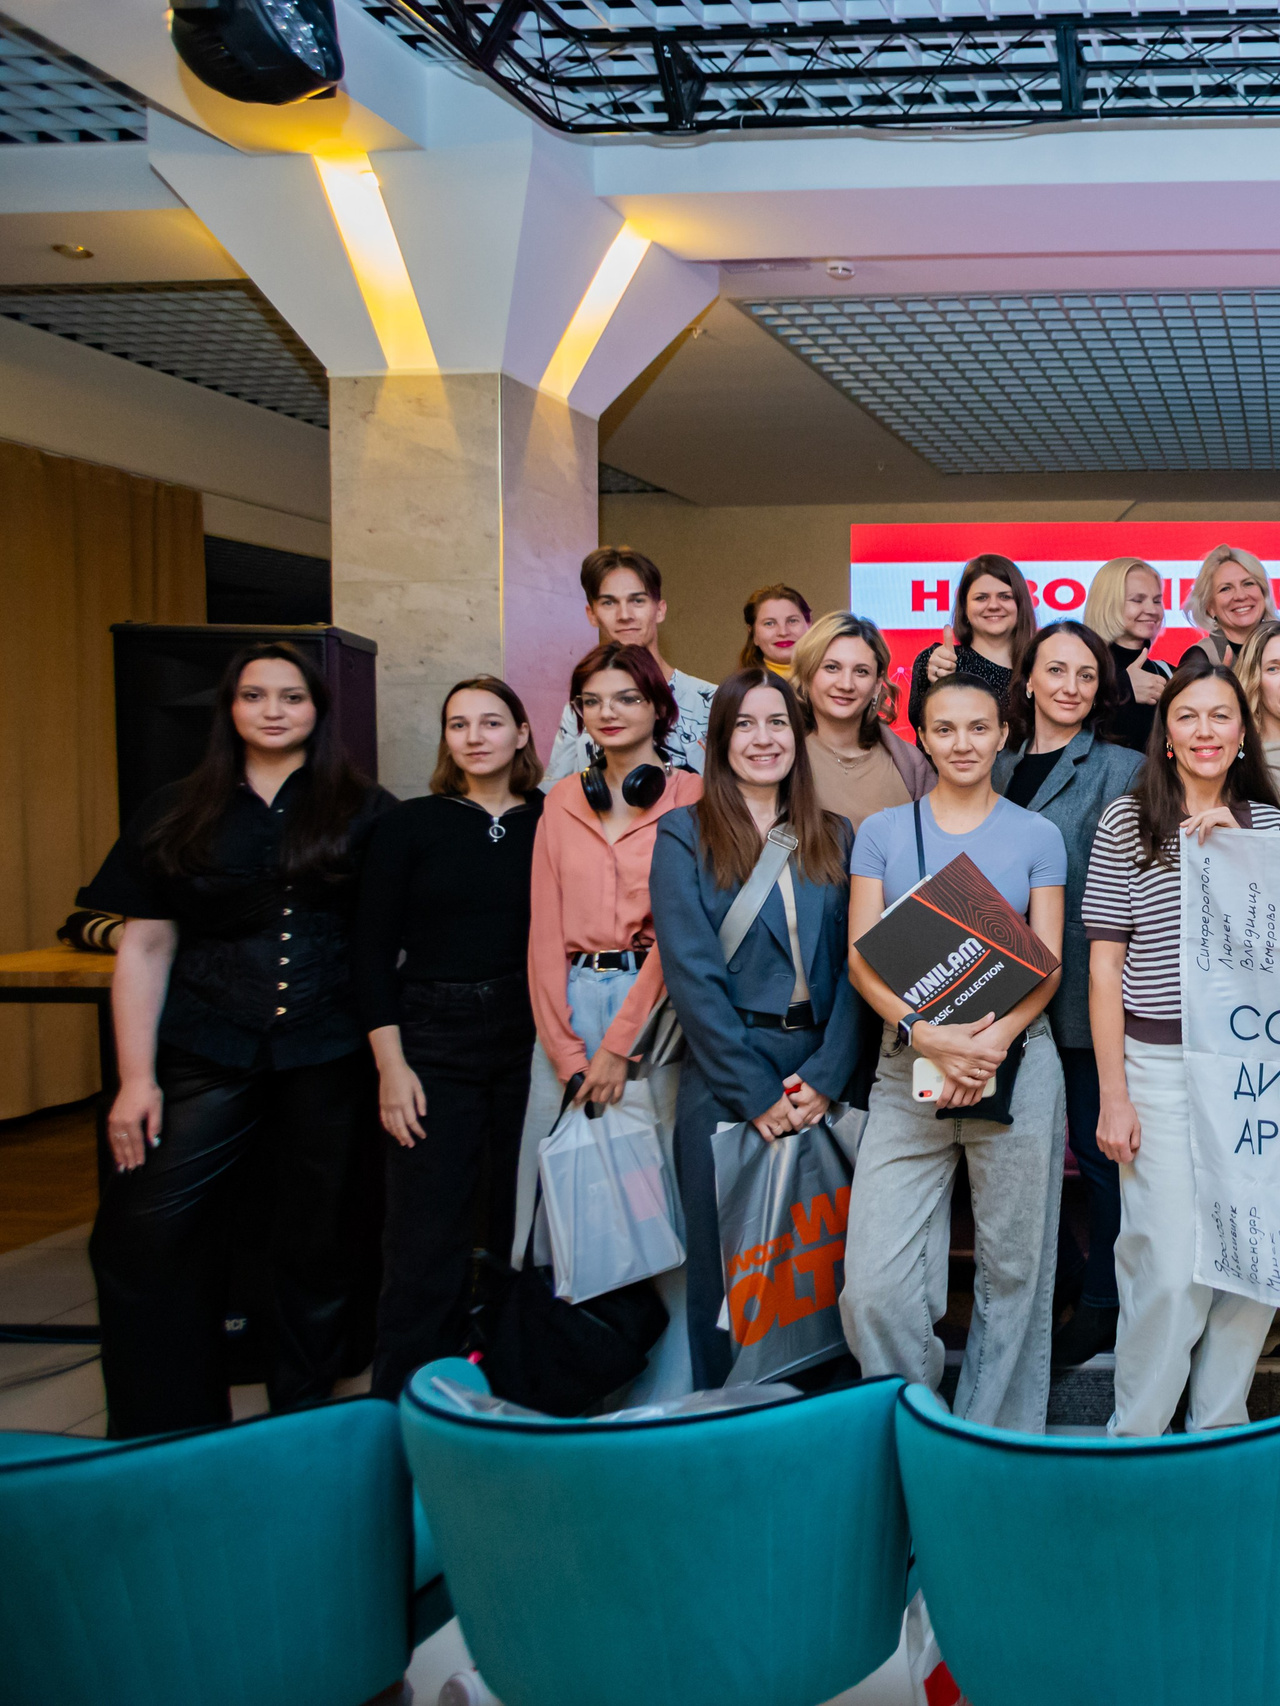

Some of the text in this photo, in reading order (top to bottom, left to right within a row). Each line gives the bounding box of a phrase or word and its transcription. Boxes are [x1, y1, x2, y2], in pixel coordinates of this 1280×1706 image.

[1196, 857, 1214, 972] Симферополь
[1240, 882, 1262, 971] Владимир
[1260, 903, 1276, 974] Кемерово
[903, 937, 983, 1005] VINILAM
[928, 961, 1005, 1026] BASIC COLLECTION
